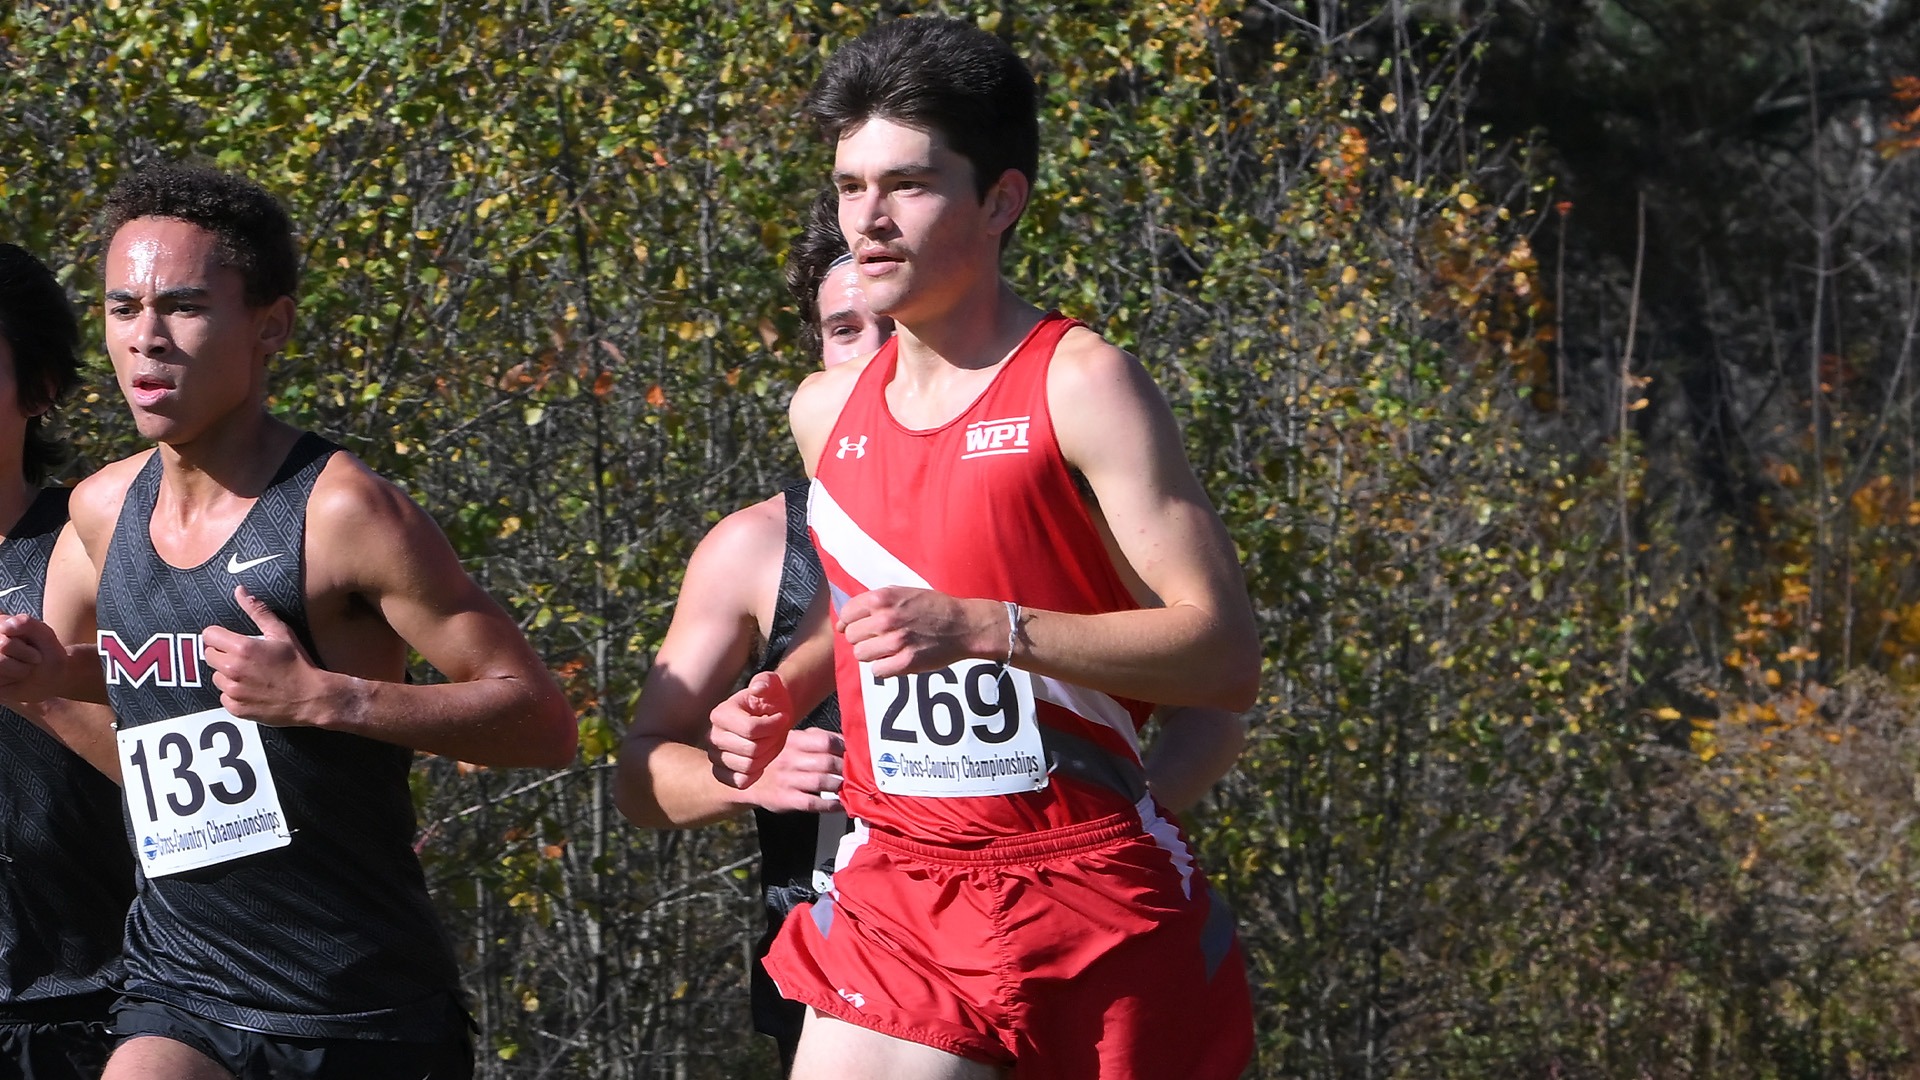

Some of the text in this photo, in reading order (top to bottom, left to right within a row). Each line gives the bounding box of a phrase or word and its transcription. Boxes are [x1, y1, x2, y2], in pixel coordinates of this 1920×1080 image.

[966, 423, 1029, 452] WPI
[97, 630, 264, 689] MI
[874, 663, 1020, 746] 269
[130, 721, 257, 823] 133
[900, 751, 1039, 782] Cross-Country Championships
[156, 808, 280, 857] Cross-Country Championships
